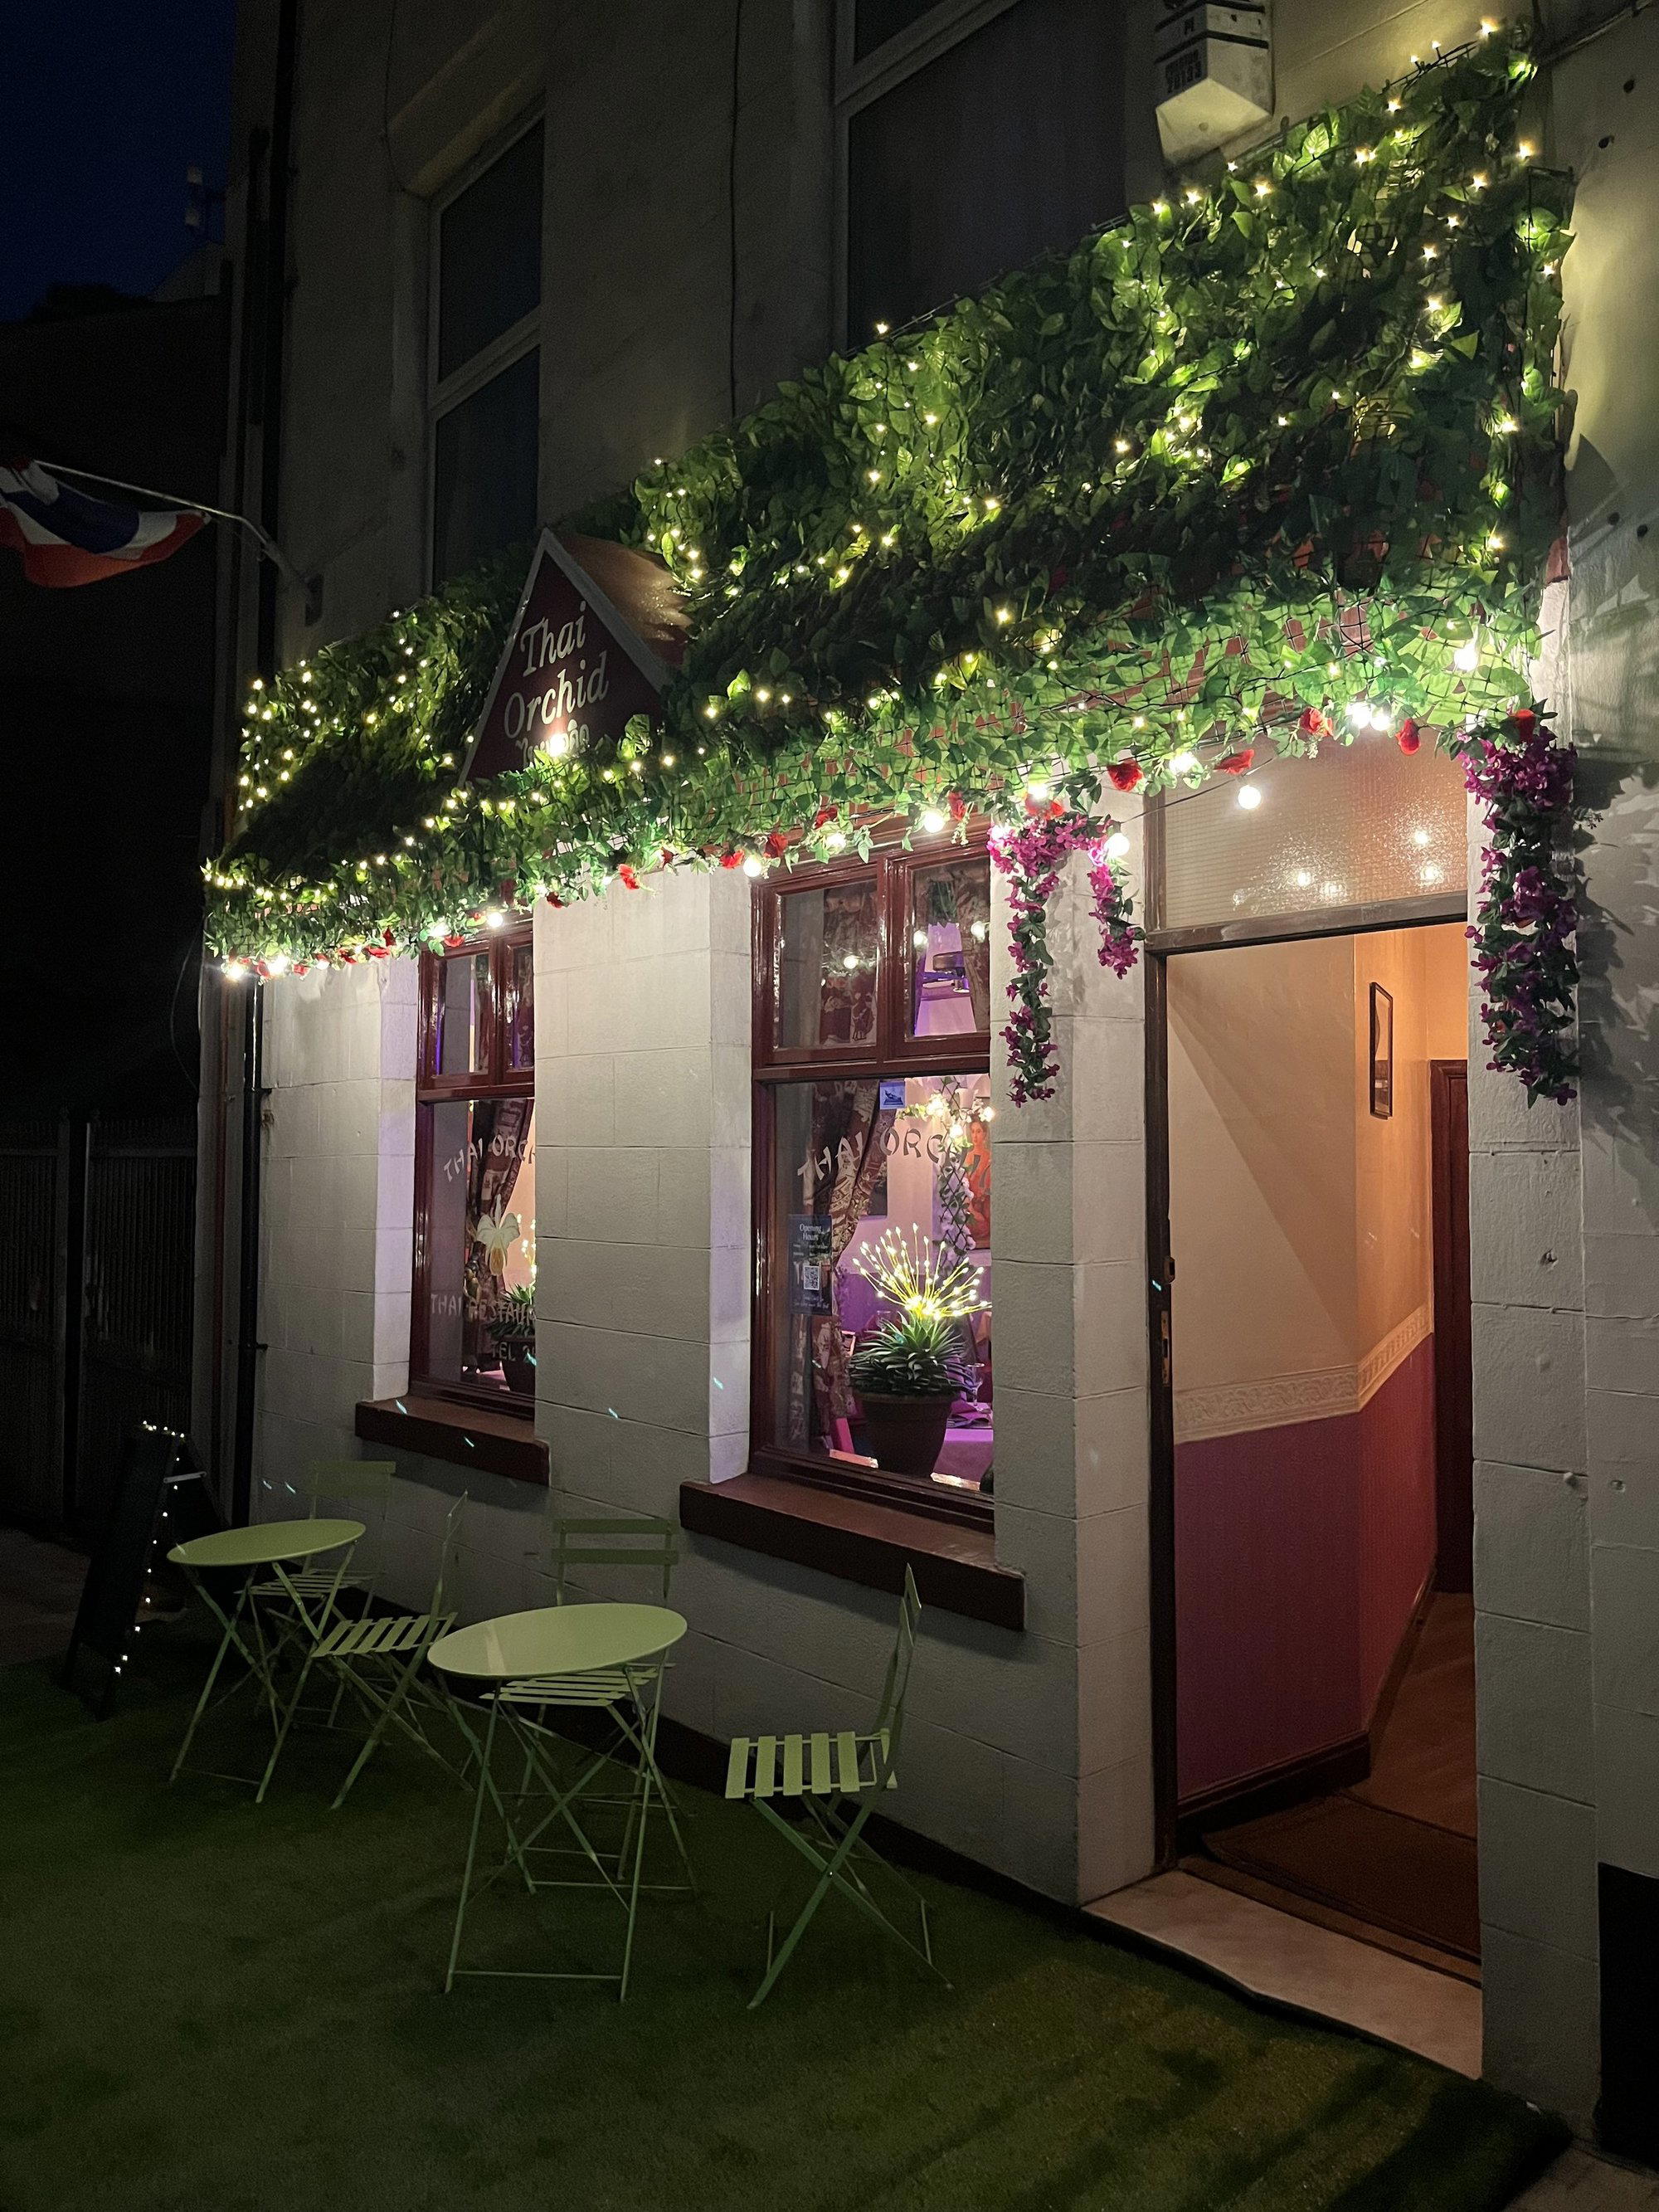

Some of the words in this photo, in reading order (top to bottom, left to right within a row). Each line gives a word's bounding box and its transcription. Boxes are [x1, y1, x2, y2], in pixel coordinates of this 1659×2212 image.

[520, 601, 586, 677] Thai
[504, 650, 609, 739] Orchid
[443, 1137, 483, 1182] THAI
[797, 1131, 863, 1182] THAI
[799, 1223, 822, 1233] Opening
[431, 1293, 463, 1317] THAI
[490, 1341, 516, 1362] TEL
